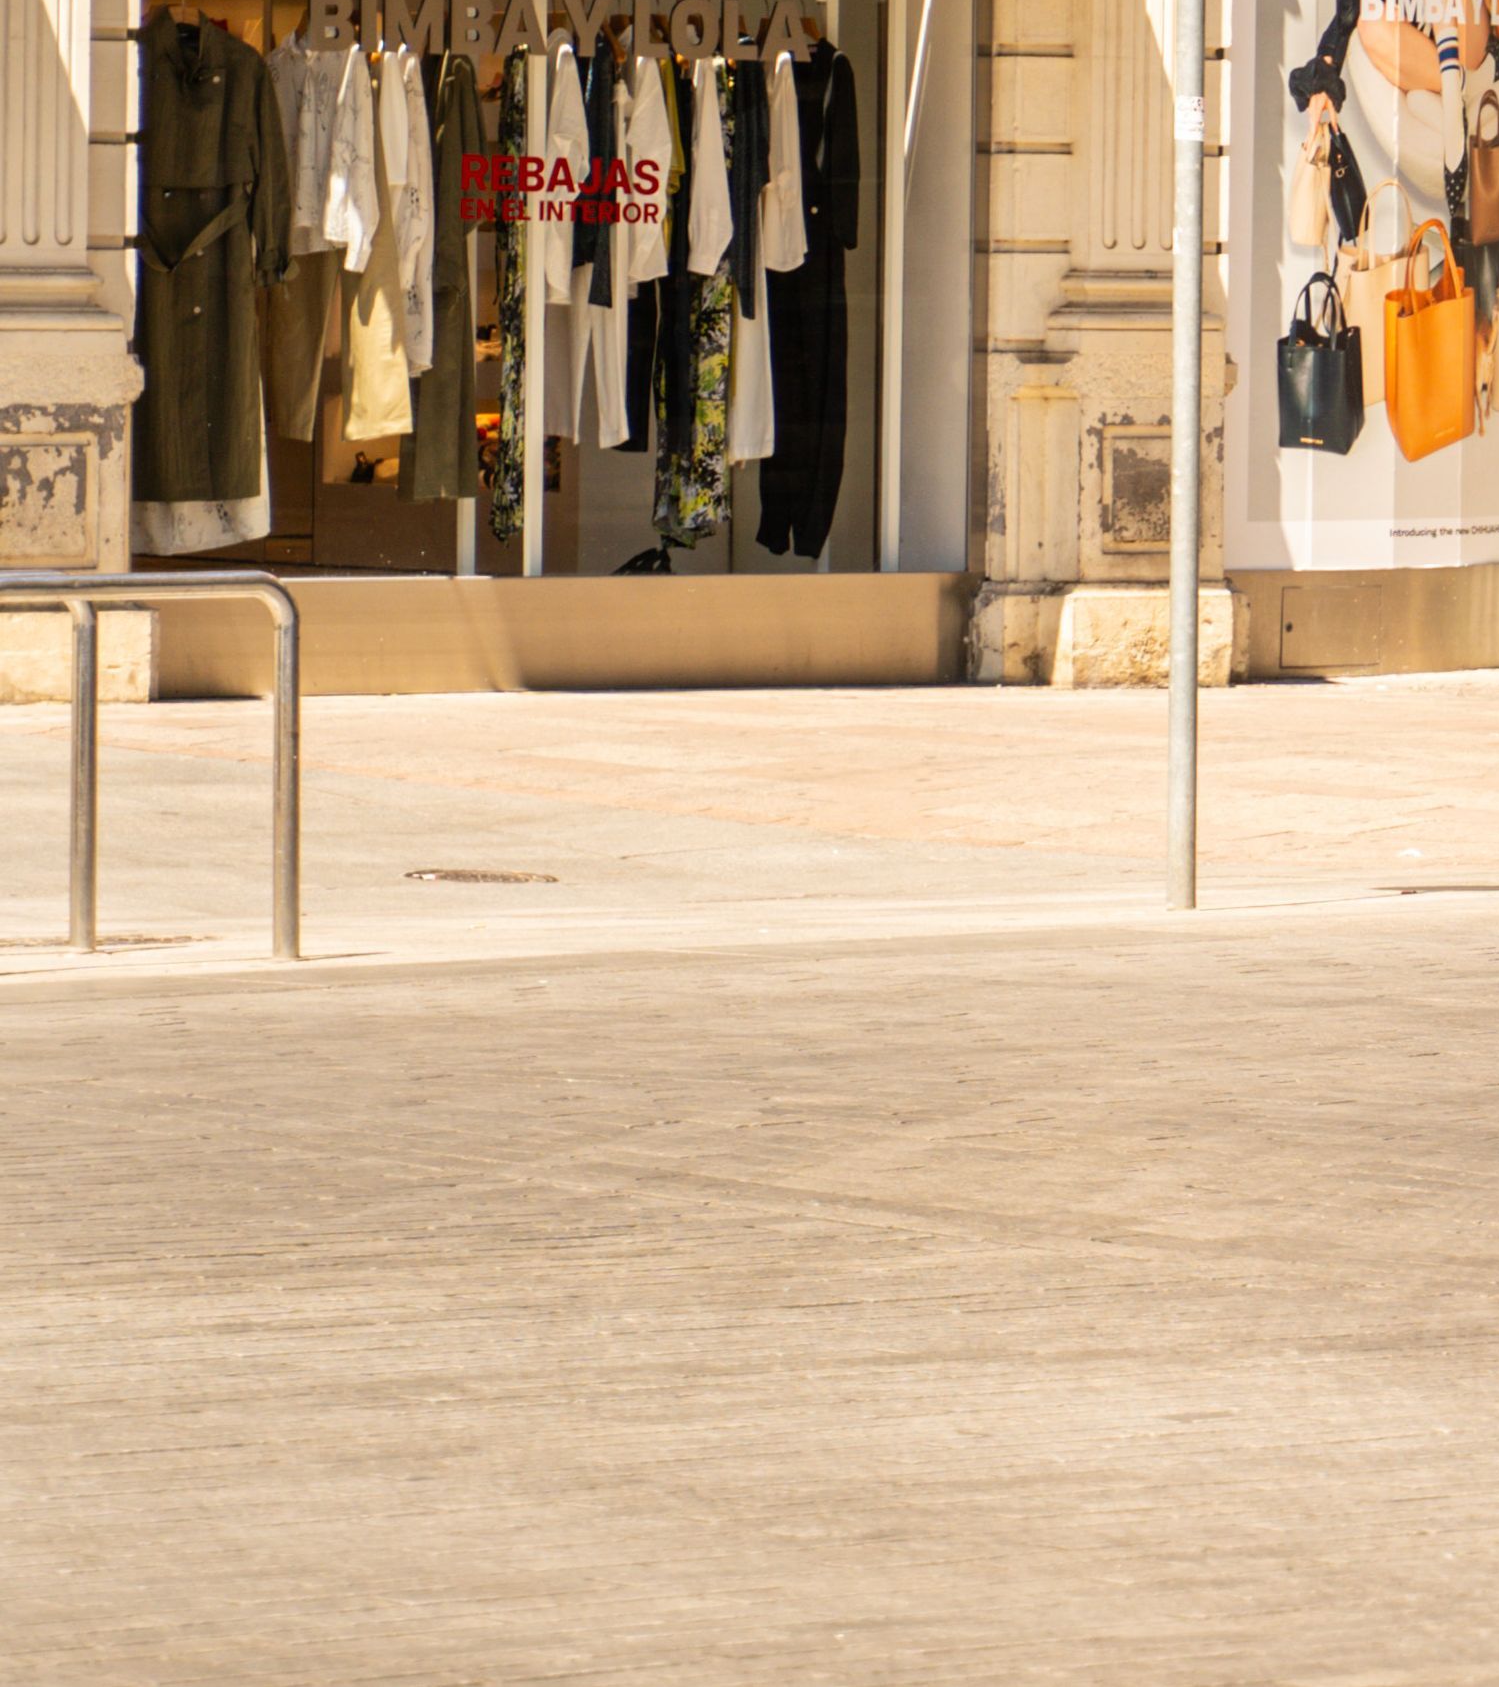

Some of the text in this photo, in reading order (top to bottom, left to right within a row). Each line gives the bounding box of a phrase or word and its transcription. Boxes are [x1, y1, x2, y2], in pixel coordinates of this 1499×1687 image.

[461, 153, 660, 196] REBAJAS
[460, 198, 660, 224] EN EL INTERIOR
